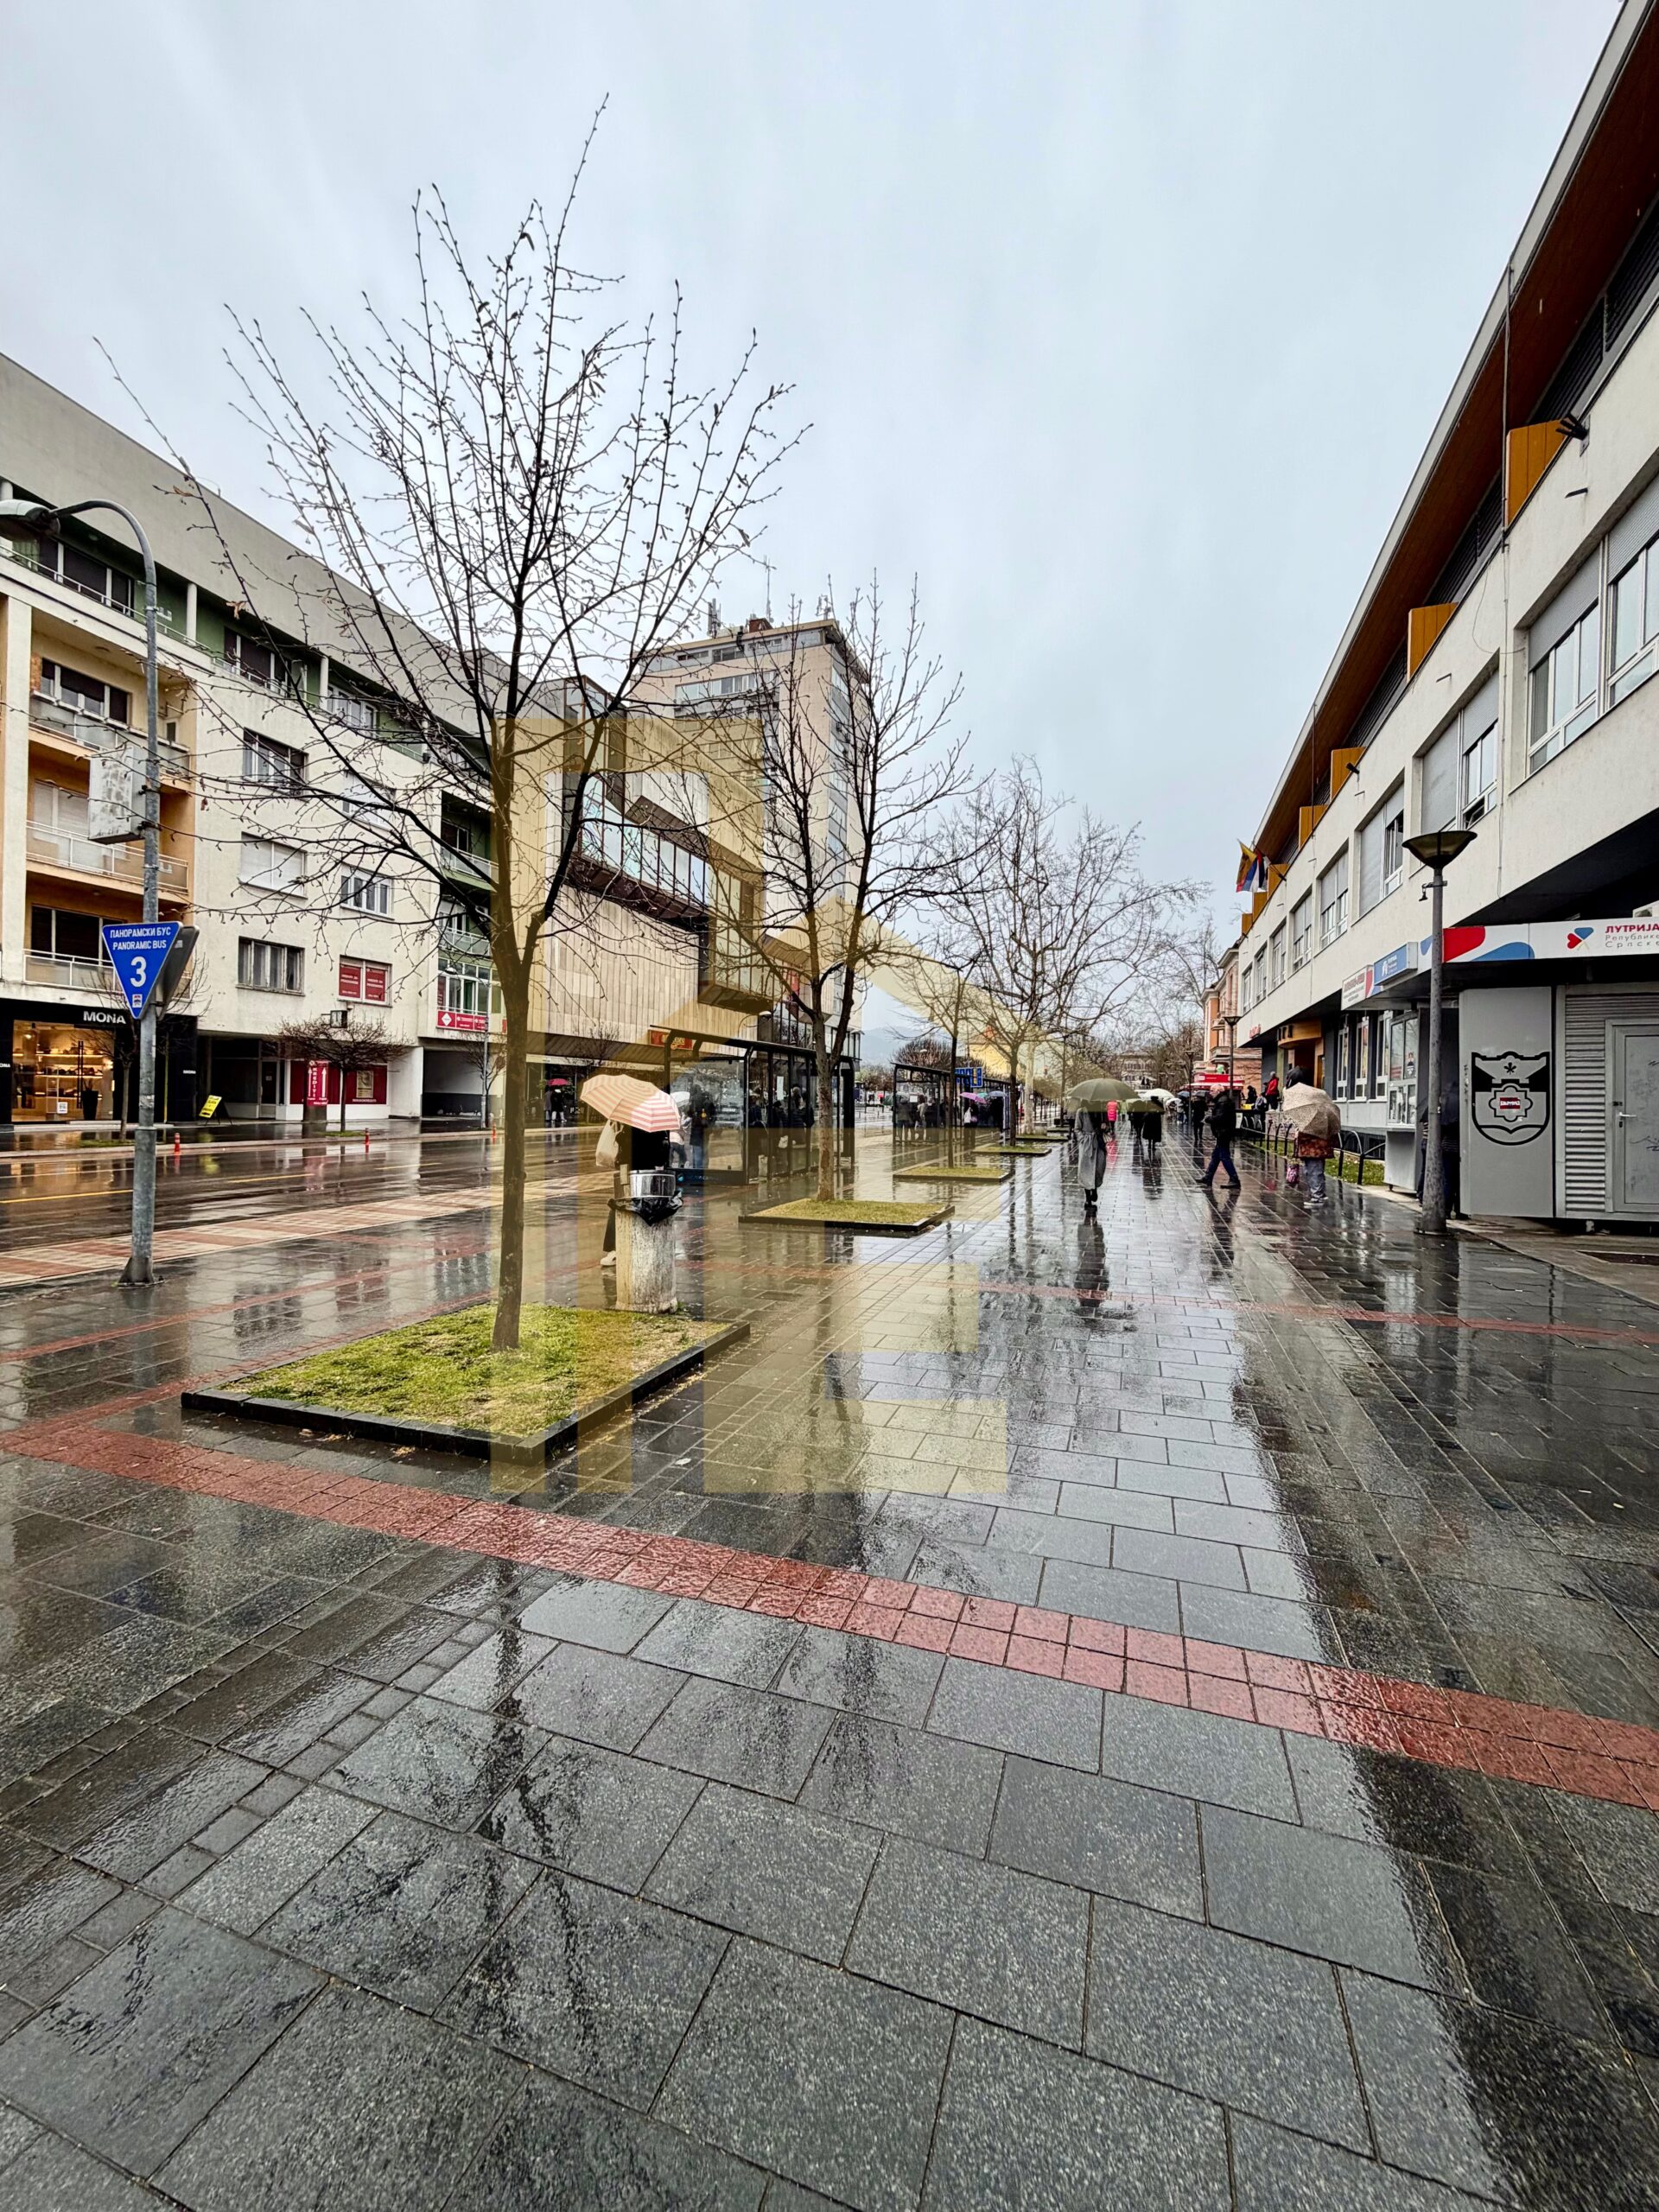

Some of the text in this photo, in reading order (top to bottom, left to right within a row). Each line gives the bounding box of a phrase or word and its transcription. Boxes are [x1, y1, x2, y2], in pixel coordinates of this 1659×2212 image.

[110, 926, 171, 938] ПАНОРАМСКИ БУС
[1605, 923, 1659, 933] ЛУТРИЈА
[112, 940, 167, 950] PANORAMIC BUS
[130, 956, 147, 988] 3
[83, 1011, 126, 1024] MONA
